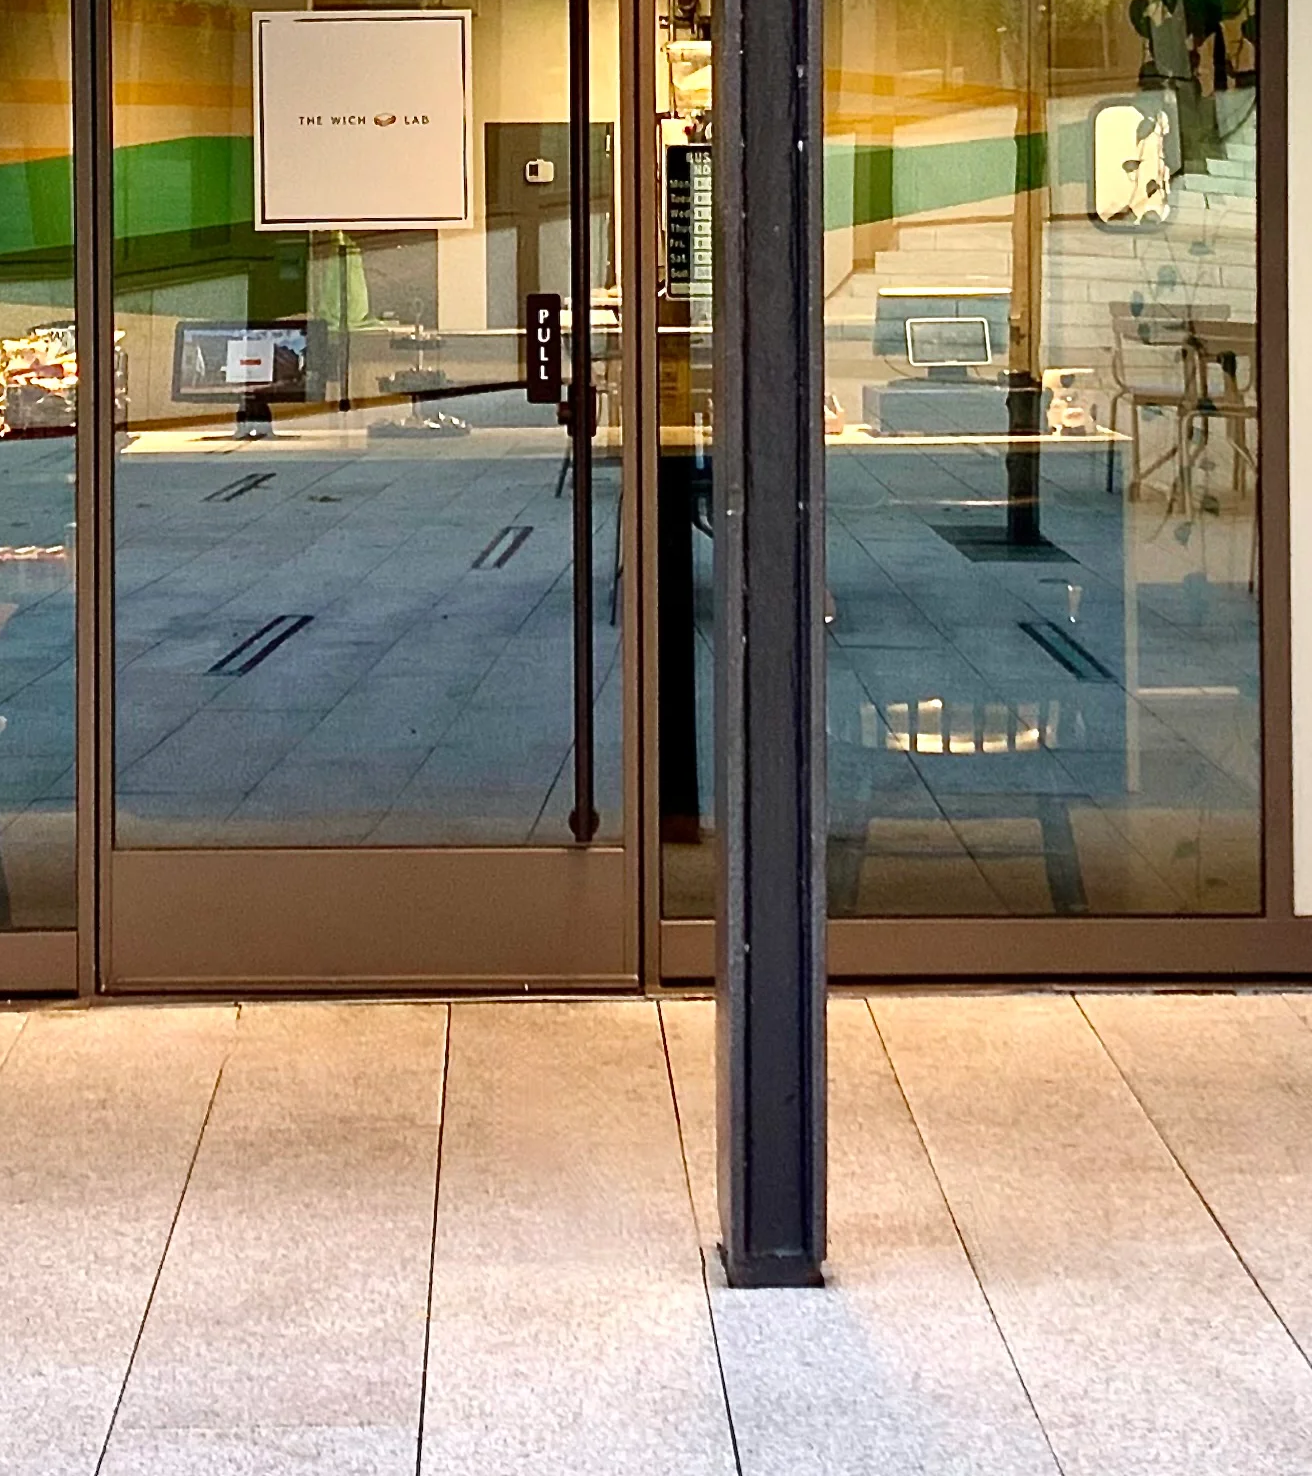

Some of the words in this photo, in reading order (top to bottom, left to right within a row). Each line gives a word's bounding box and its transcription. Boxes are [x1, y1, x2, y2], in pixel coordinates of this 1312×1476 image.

[298, 115, 323, 126] THE
[330, 115, 366, 126] WICH
[403, 115, 430, 126] LAB
[537, 309, 551, 380] PULL
